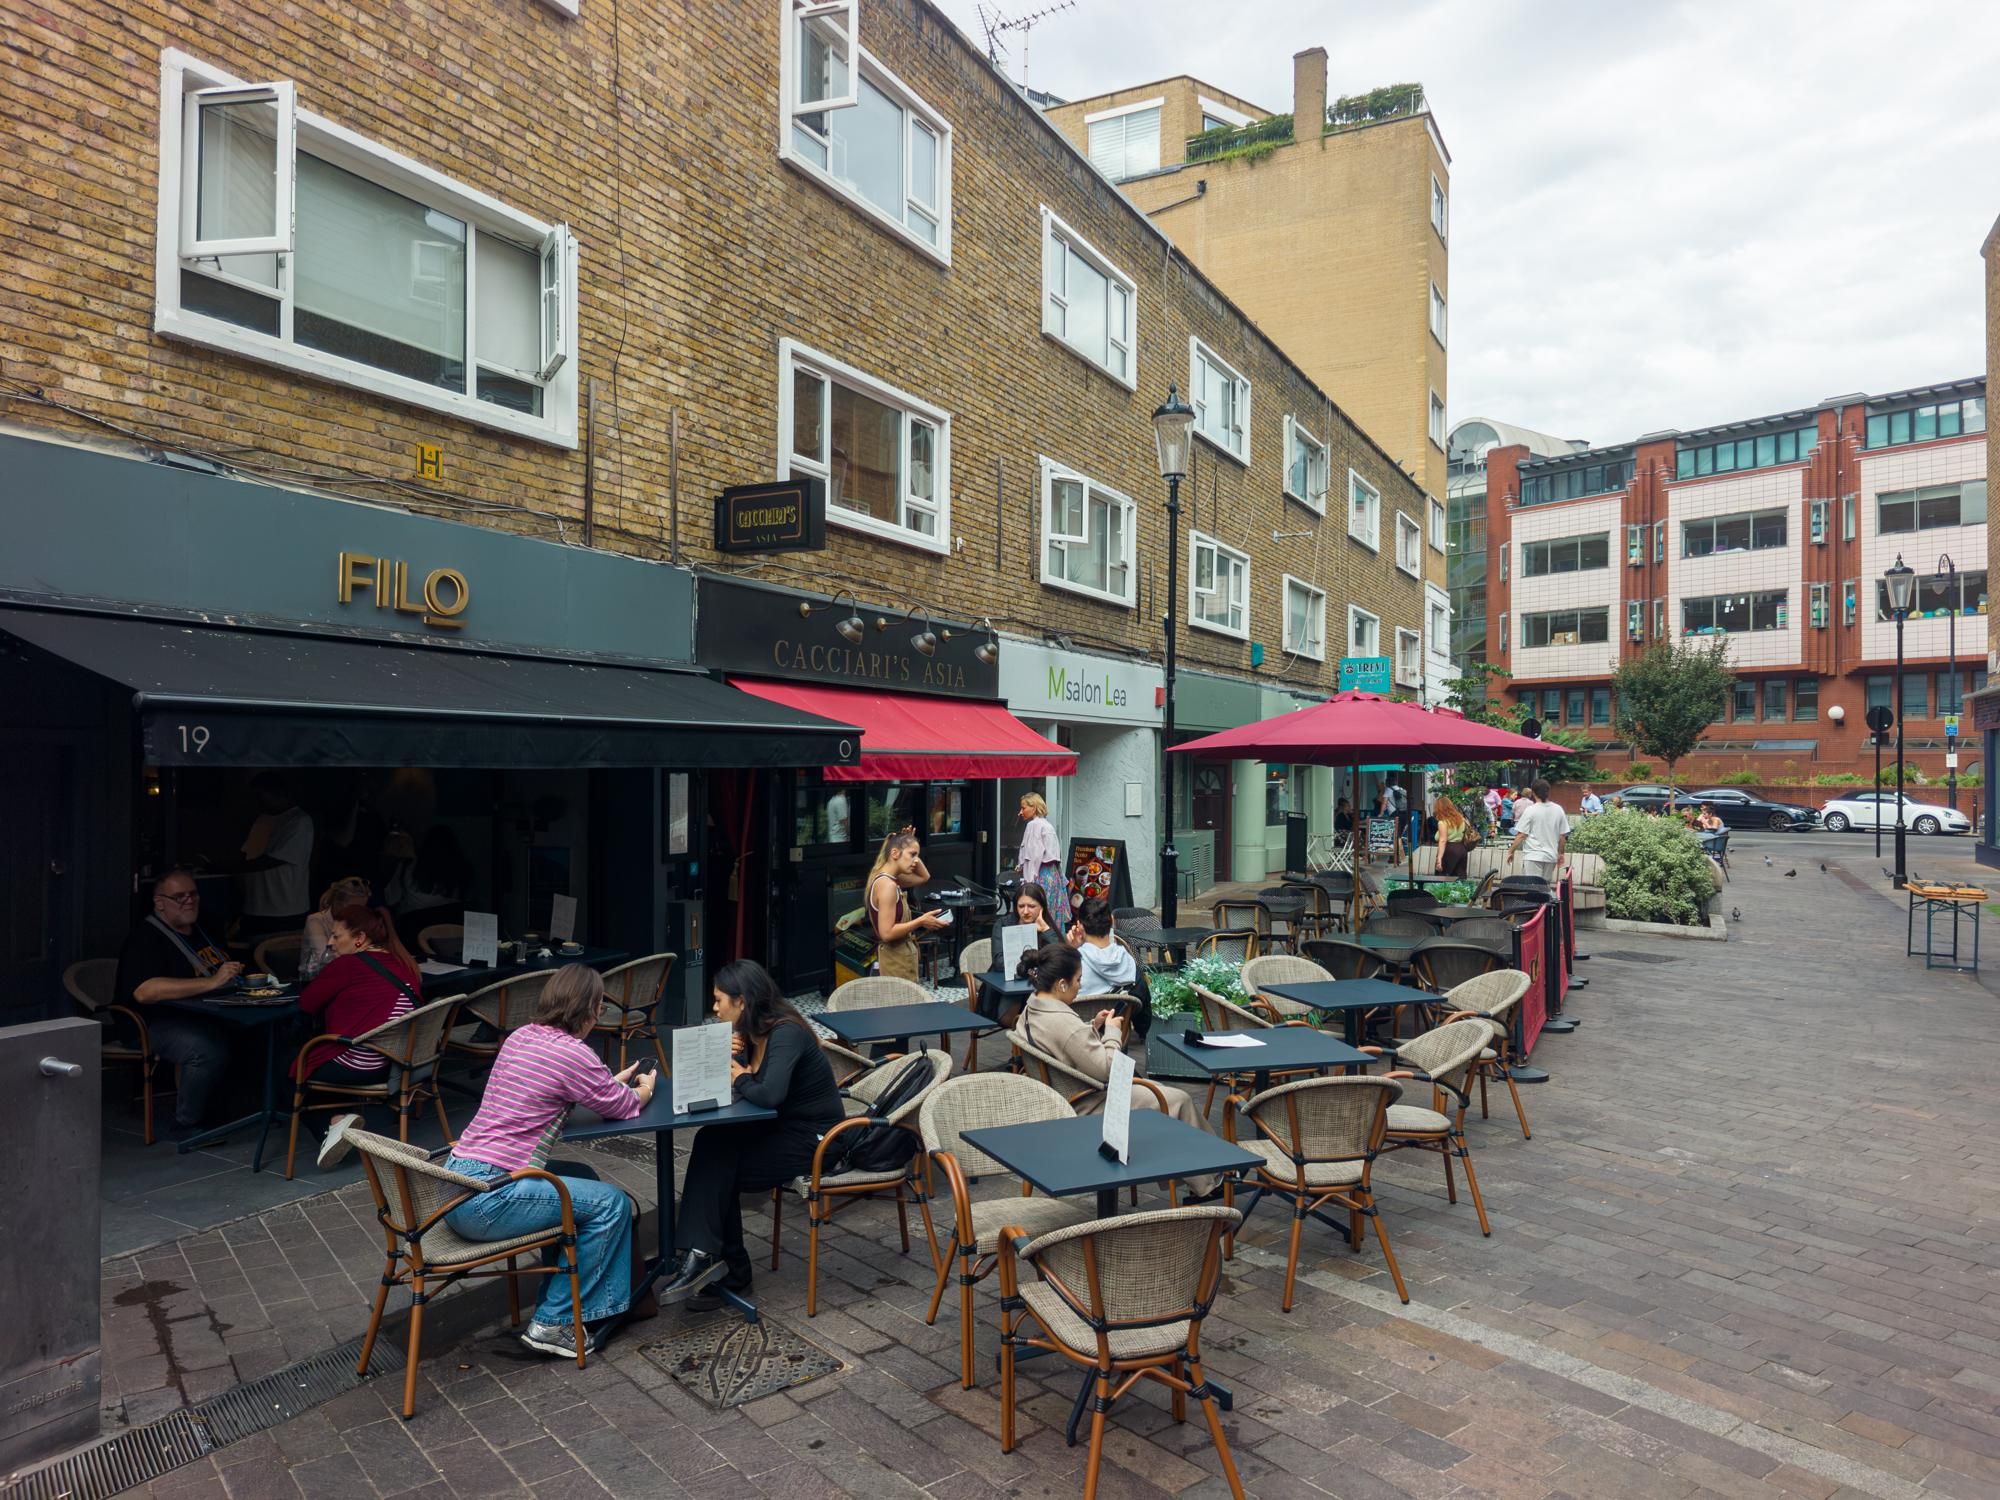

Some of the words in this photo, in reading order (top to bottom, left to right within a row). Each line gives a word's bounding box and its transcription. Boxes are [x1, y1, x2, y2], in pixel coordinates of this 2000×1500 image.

[420, 446, 440, 478] H
[755, 533, 777, 543] ASIA
[338, 551, 470, 622] FILO
[774, 639, 910, 682] CACCIARI'S
[922, 661, 967, 688] ASIA
[1048, 665, 1101, 704] Msalon
[1105, 673, 1127, 706] Lea
[178, 725, 210, 753] 19
